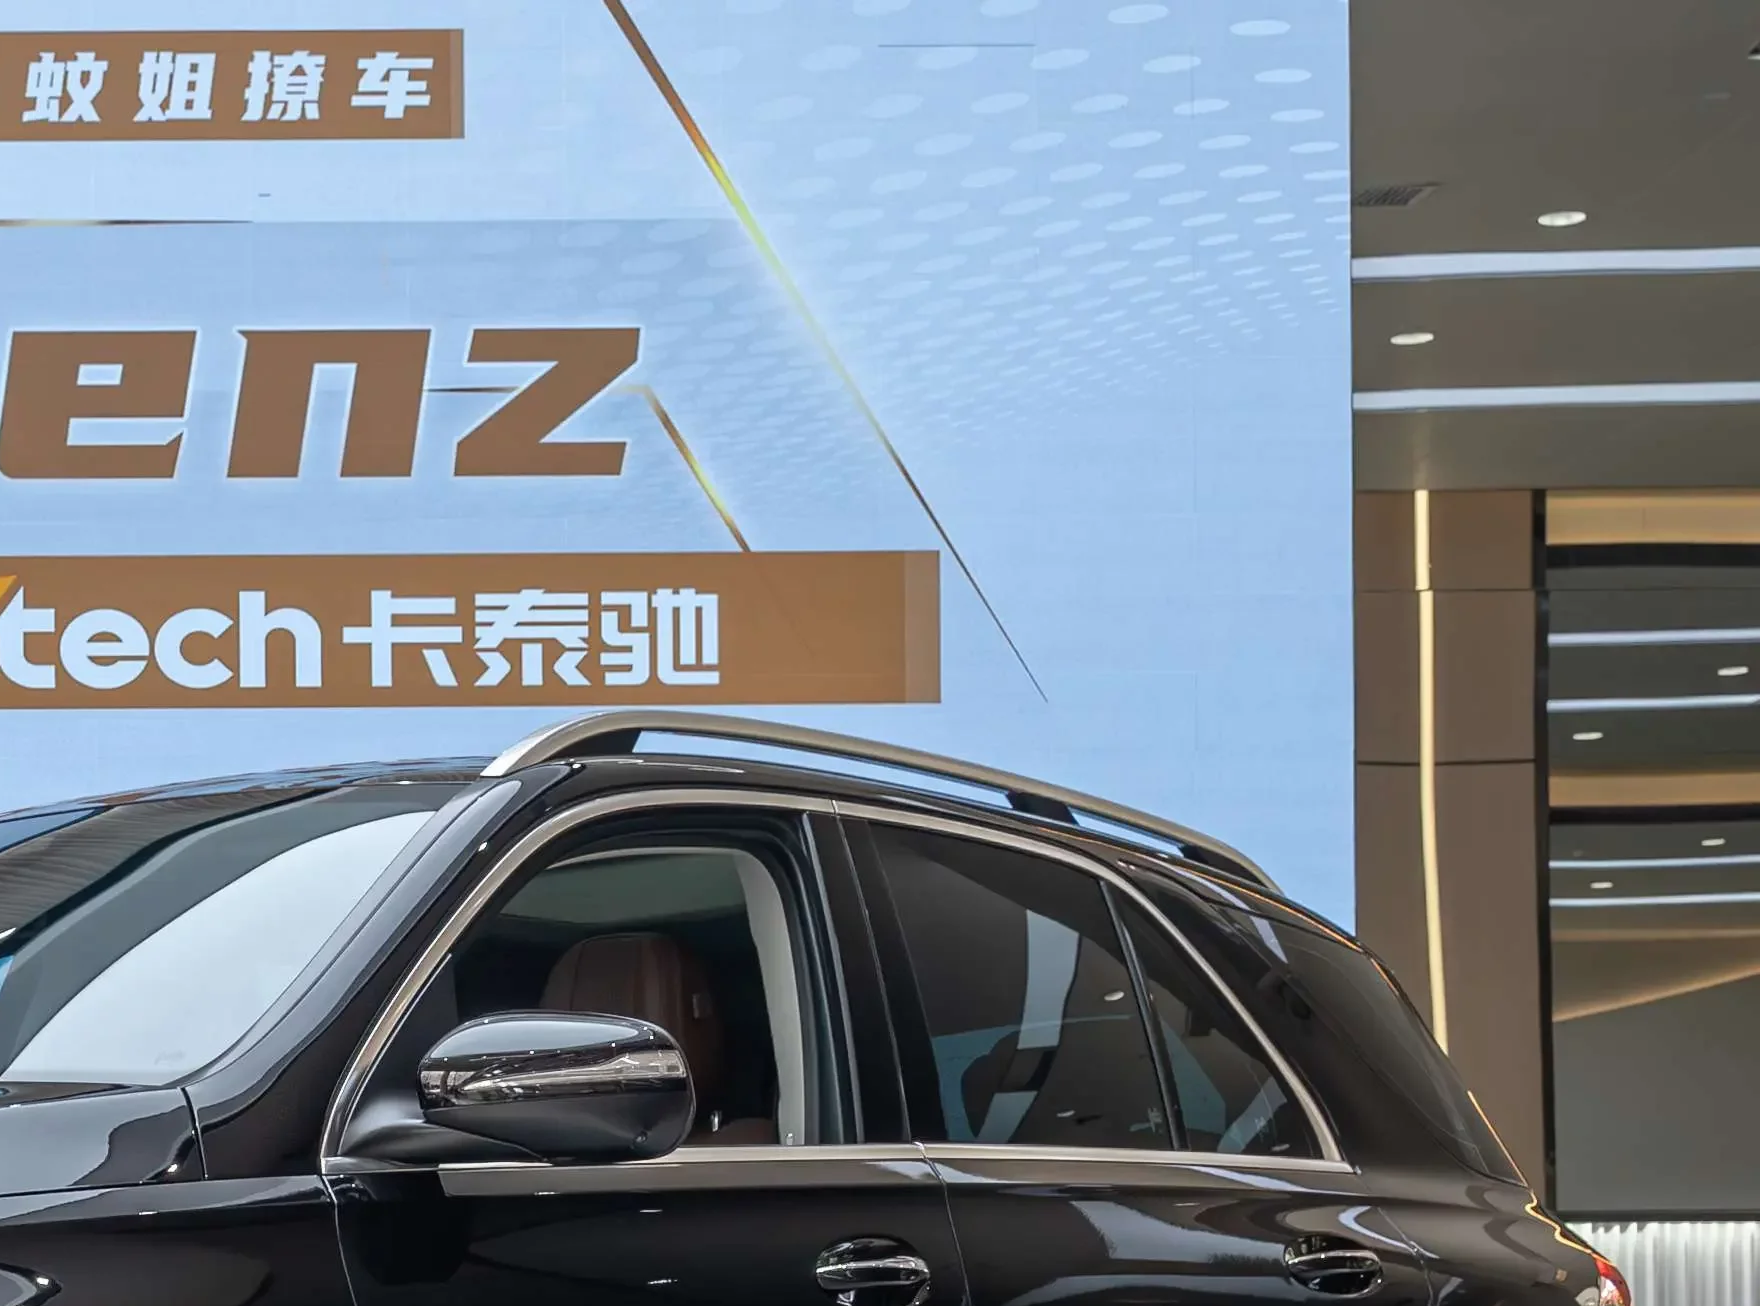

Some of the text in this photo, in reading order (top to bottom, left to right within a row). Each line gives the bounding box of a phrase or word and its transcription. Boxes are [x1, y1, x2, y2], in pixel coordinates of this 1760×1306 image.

[22, 50, 434, 122] 蚊姐撩车
[342, 588, 721, 690] 卡泰驰
